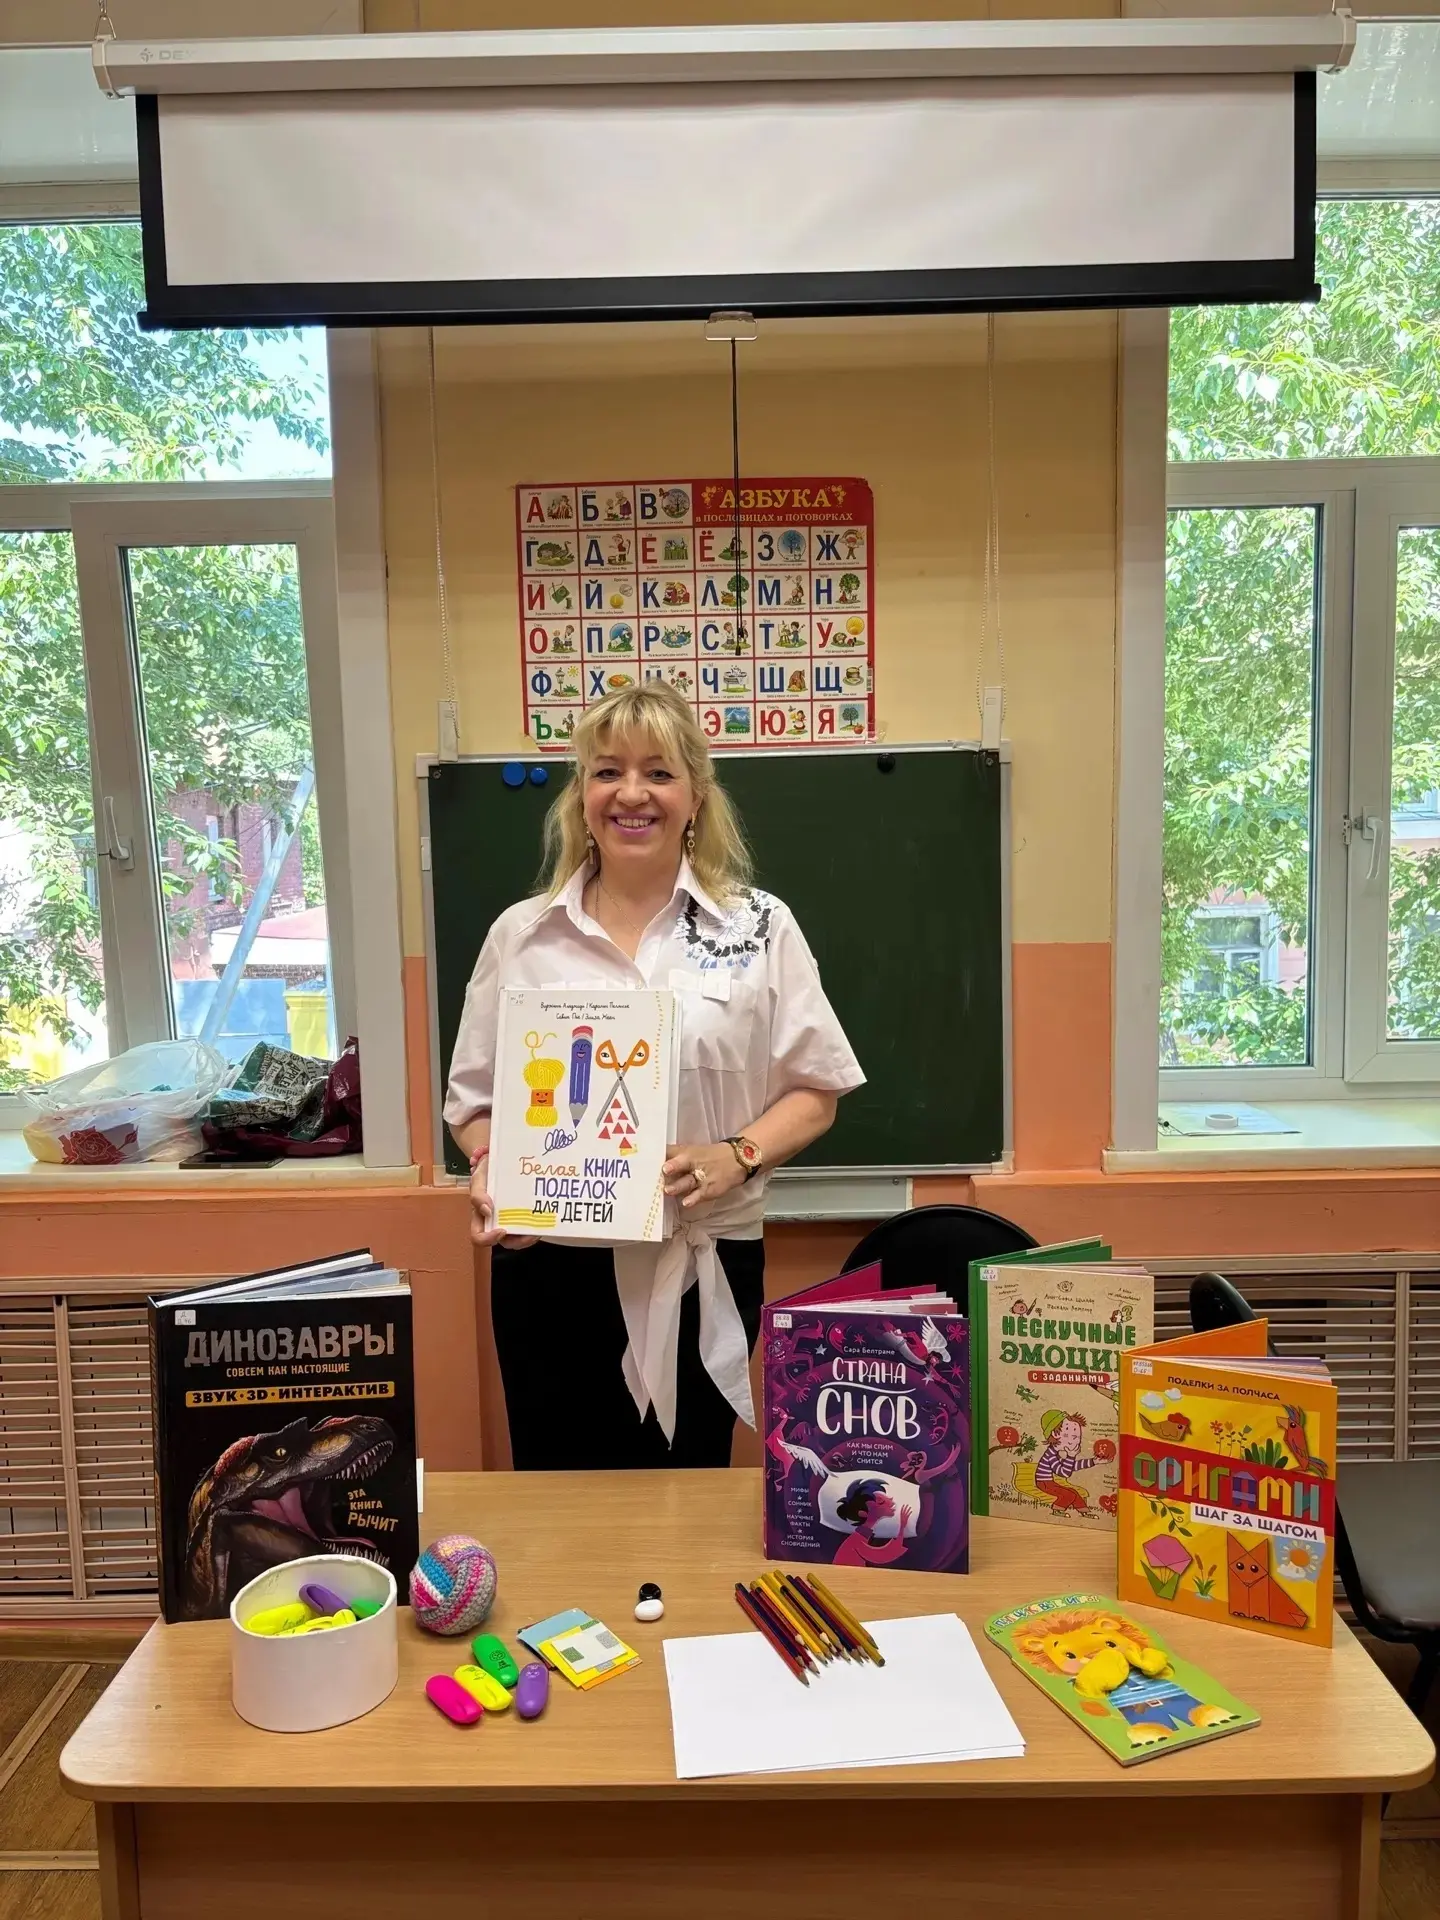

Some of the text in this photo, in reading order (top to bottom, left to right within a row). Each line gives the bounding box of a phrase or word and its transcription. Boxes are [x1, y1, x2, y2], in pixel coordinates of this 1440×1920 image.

[526, 497, 545, 523] А
[583, 495, 599, 521] Б
[640, 493, 657, 520] В
[719, 489, 831, 508] АЗБУКА
[703, 514, 775, 523] ПОСЛОВИЦАХ
[785, 513, 853, 521] ПОГОВОРКАХ
[526, 541, 539, 566] Г
[584, 540, 604, 566] Д
[642, 537, 657, 564] Е
[699, 530, 715, 562] Ё
[758, 534, 773, 561] З
[816, 535, 841, 560] Ж
[528, 584, 545, 610] И
[586, 579, 603, 610] Й
[643, 582, 660, 608] К
[701, 580, 719, 606] Л
[758, 579, 780, 605] М
[816, 579, 832, 605] Н
[529, 627, 548, 654] О
[587, 627, 603, 653] П
[644, 626, 660, 652] Р
[701, 624, 719, 650] С
[759, 624, 774, 649] Т
[816, 622, 833, 648] У
[531, 670, 552, 697] Ф
[590, 671, 605, 696] Х
[702, 668, 718, 693] Ч
[760, 667, 784, 693] Ш
[815, 667, 842, 693] Щ
[704, 710, 721, 737] Э
[760, 710, 785, 736] Ю
[818, 708, 834, 734] Я
[519, 1156, 631, 1178] Белая КНИГА
[535, 1177, 617, 1200] ПОДЕЛОК
[532, 1200, 614, 1223] ДЛЯ ДЕТЕЙ
[1002, 1315, 1136, 1346] НЕСКУЧНЫЕ
[184, 1323, 395, 1368] ДИНОЗАВРЫ
[863, 1347, 895, 1355] Белтраме
[999, 1341, 1119, 1375] ЭМОЦИ
[226, 1363, 350, 1378] СОВСЕМ КАК НАСТОЯЩИЕ
[832, 1357, 906, 1385] СТРАНА
[1042, 1373, 1104, 1383] ЗАДАНИЯМИ
[192, 1383, 389, 1404] ЗВУК 3D ИНТЕРАКТИВ
[1167, 1376, 1280, 1401] ПОДЕЛКИ ЗА ПОЛЧАСА
[816, 1387, 921, 1440] СНОВ
[856, 1457, 883, 1465] СНИТСЯ
[348, 1489, 366, 1500] ЭТА
[1133, 1451, 1320, 1522] ОРИГАМИ
[350, 1500, 383, 1511] КНИГА
[348, 1512, 398, 1532] РЫЧИТ
[790, 1520, 811, 1528] ФАКТЫ
[1195, 1505, 1318, 1541] ШАГ ЗА ШАГОМ
[780, 1540, 820, 1548] СНОВИДЕНИЙ
